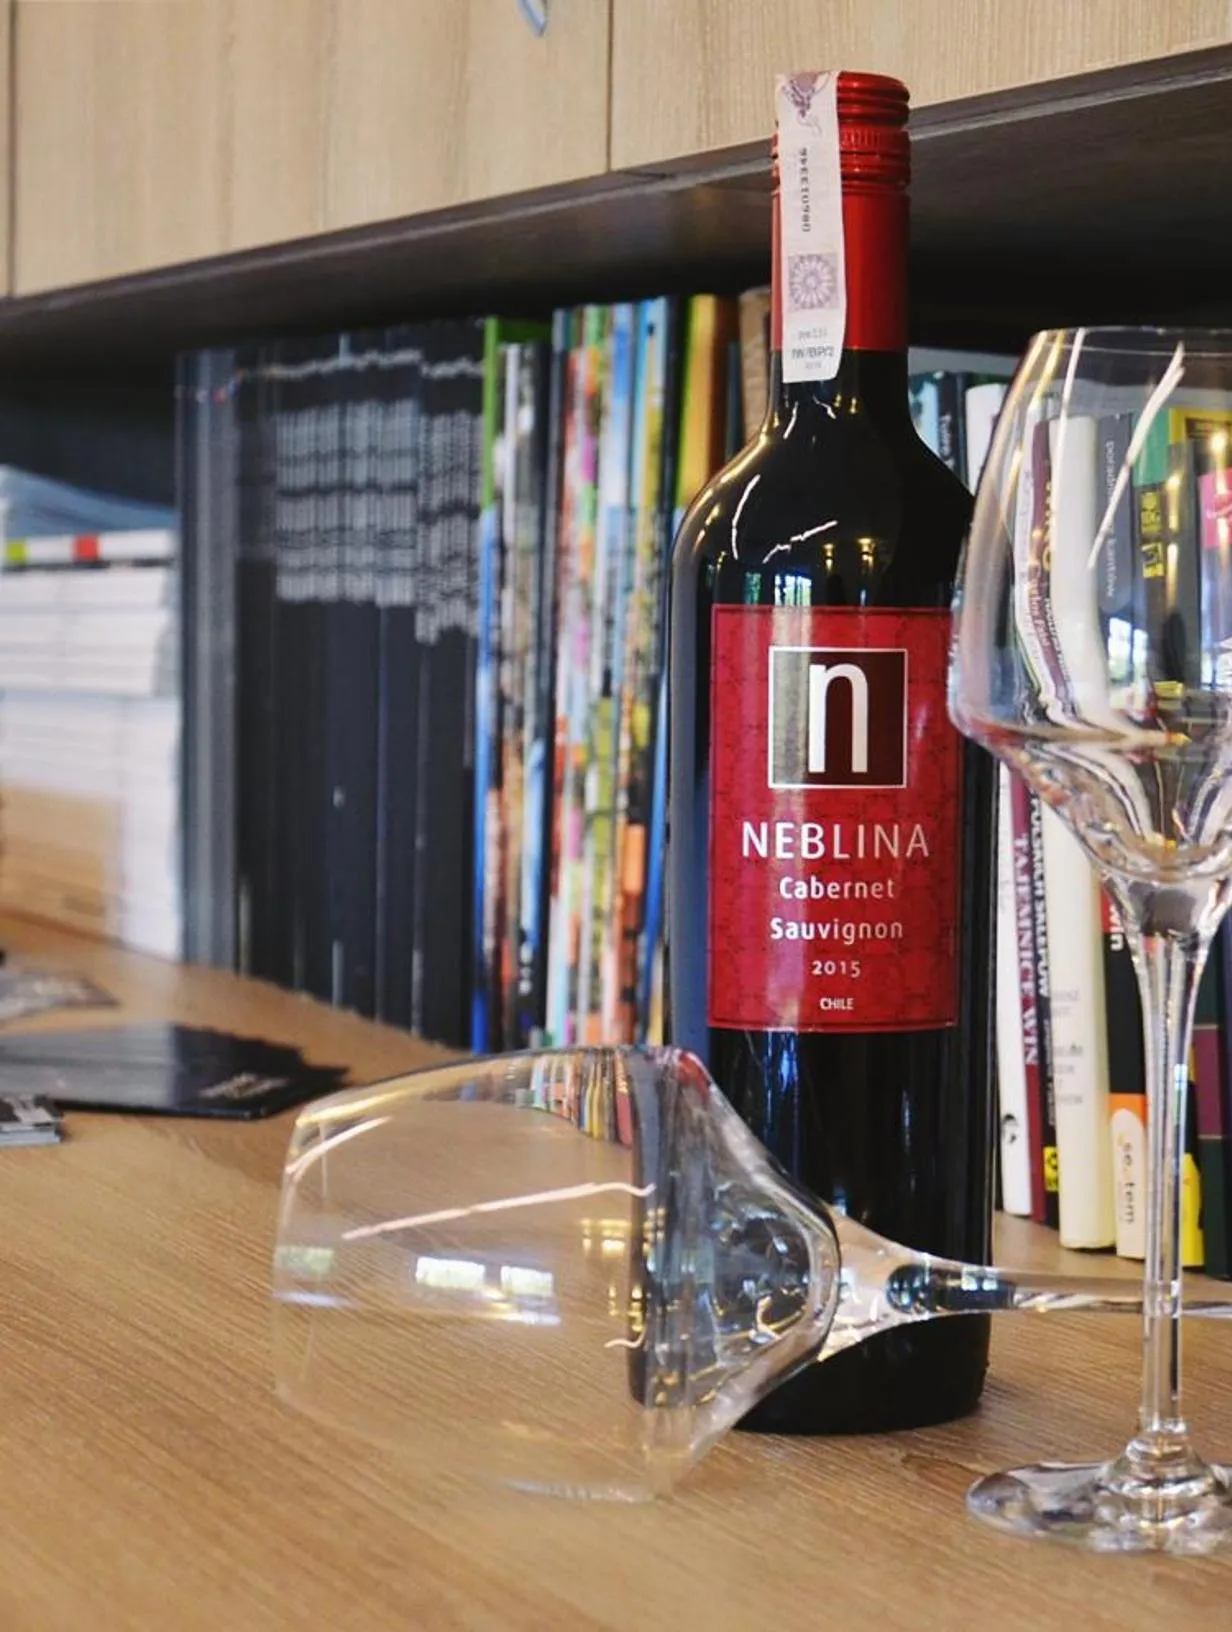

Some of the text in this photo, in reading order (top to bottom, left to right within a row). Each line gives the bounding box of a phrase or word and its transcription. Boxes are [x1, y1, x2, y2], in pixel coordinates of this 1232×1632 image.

[807, 663, 868, 773] n
[741, 822, 930, 860] NEBLINA
[779, 876, 894, 899] Cabernet
[770, 917, 904, 945] Sauvignon
[811, 960, 861, 977] 2015
[819, 996, 854, 1010] CHILE
